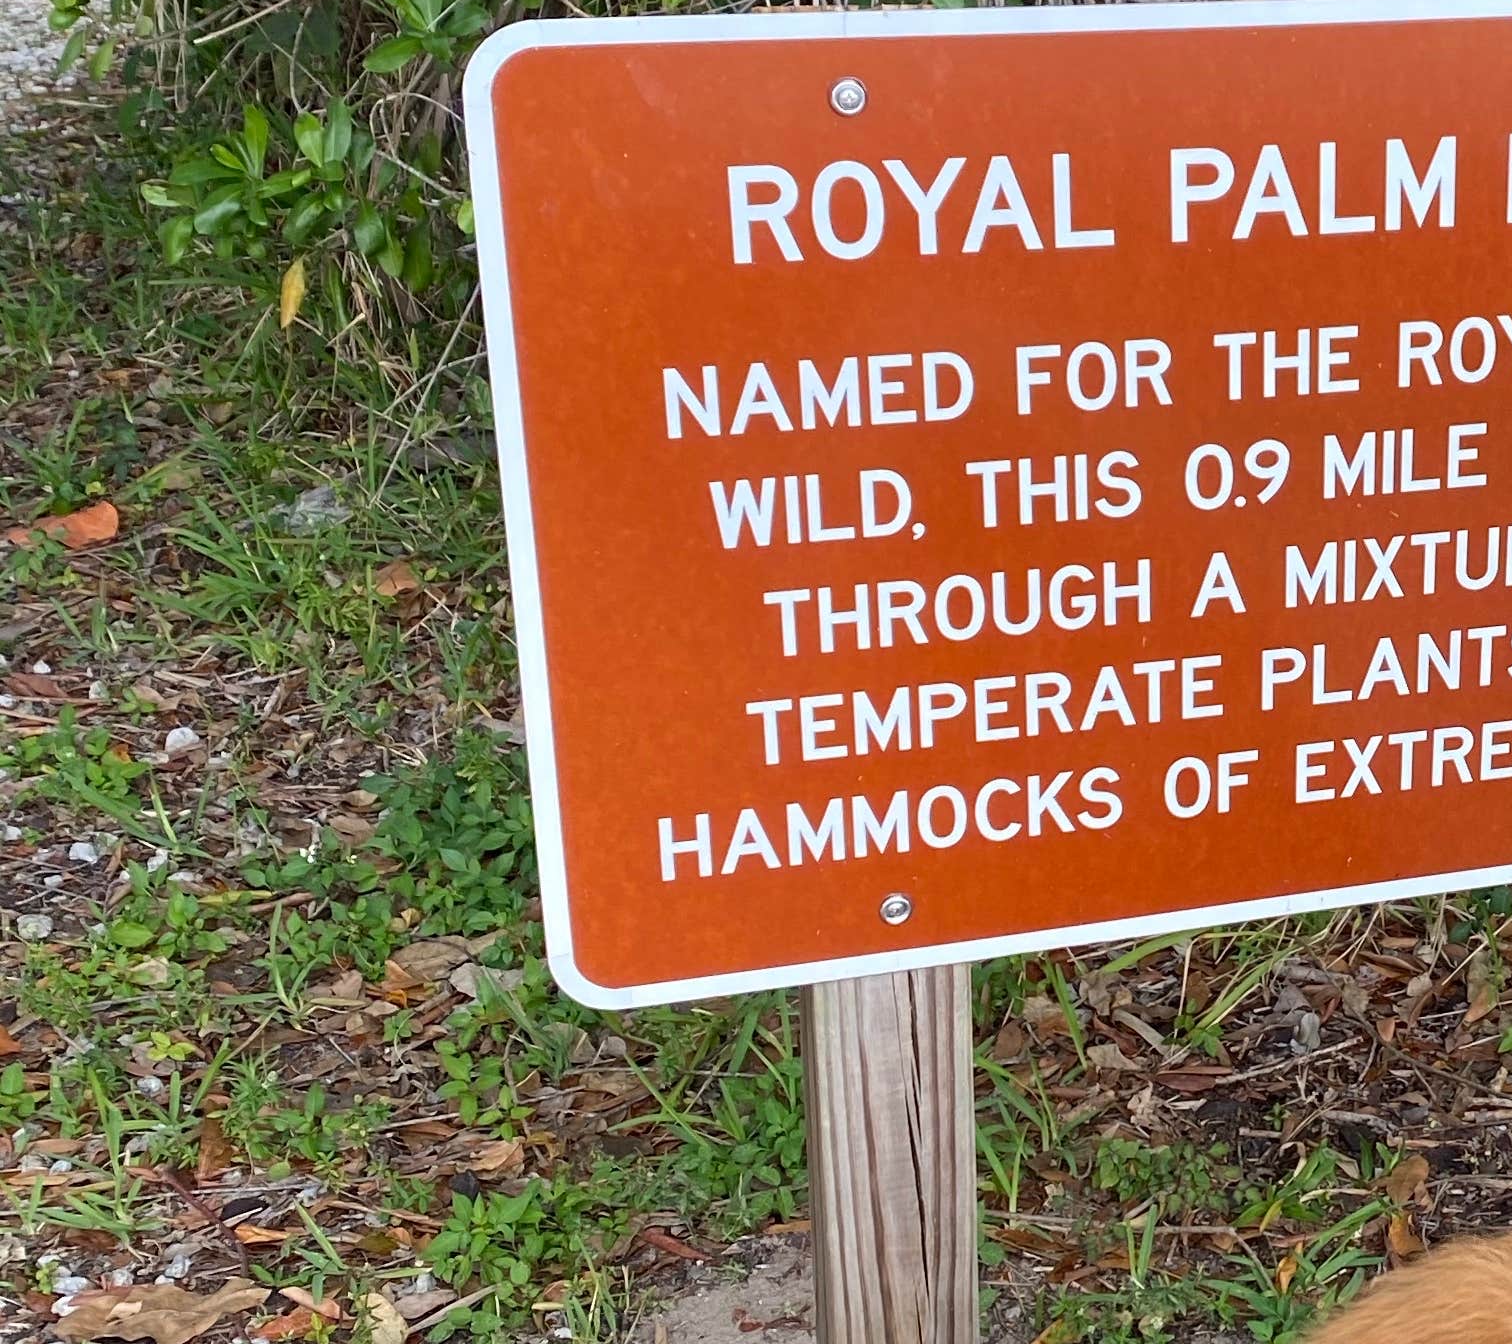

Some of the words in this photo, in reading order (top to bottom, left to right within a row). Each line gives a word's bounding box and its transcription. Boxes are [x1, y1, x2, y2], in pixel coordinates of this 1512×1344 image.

[726, 151, 1117, 266] ROYAL
[1169, 134, 1458, 244] PALM
[661, 350, 976, 441] NAMED
[1014, 337, 1174, 417] FOR
[1212, 324, 1361, 402] THE
[707, 467, 927, 551] WILD,
[964, 449, 1143, 529] THIS
[1183, 438, 1292, 512] 0.9
[1322, 421, 1489, 501] MILE
[762, 557, 1152, 658] THROUGH
[1189, 550, 1248, 619] A
[744, 653, 1225, 767] TEMPERATE
[656, 765, 1124, 883] HAMMOCKS
[1162, 748, 1260, 820] OF
